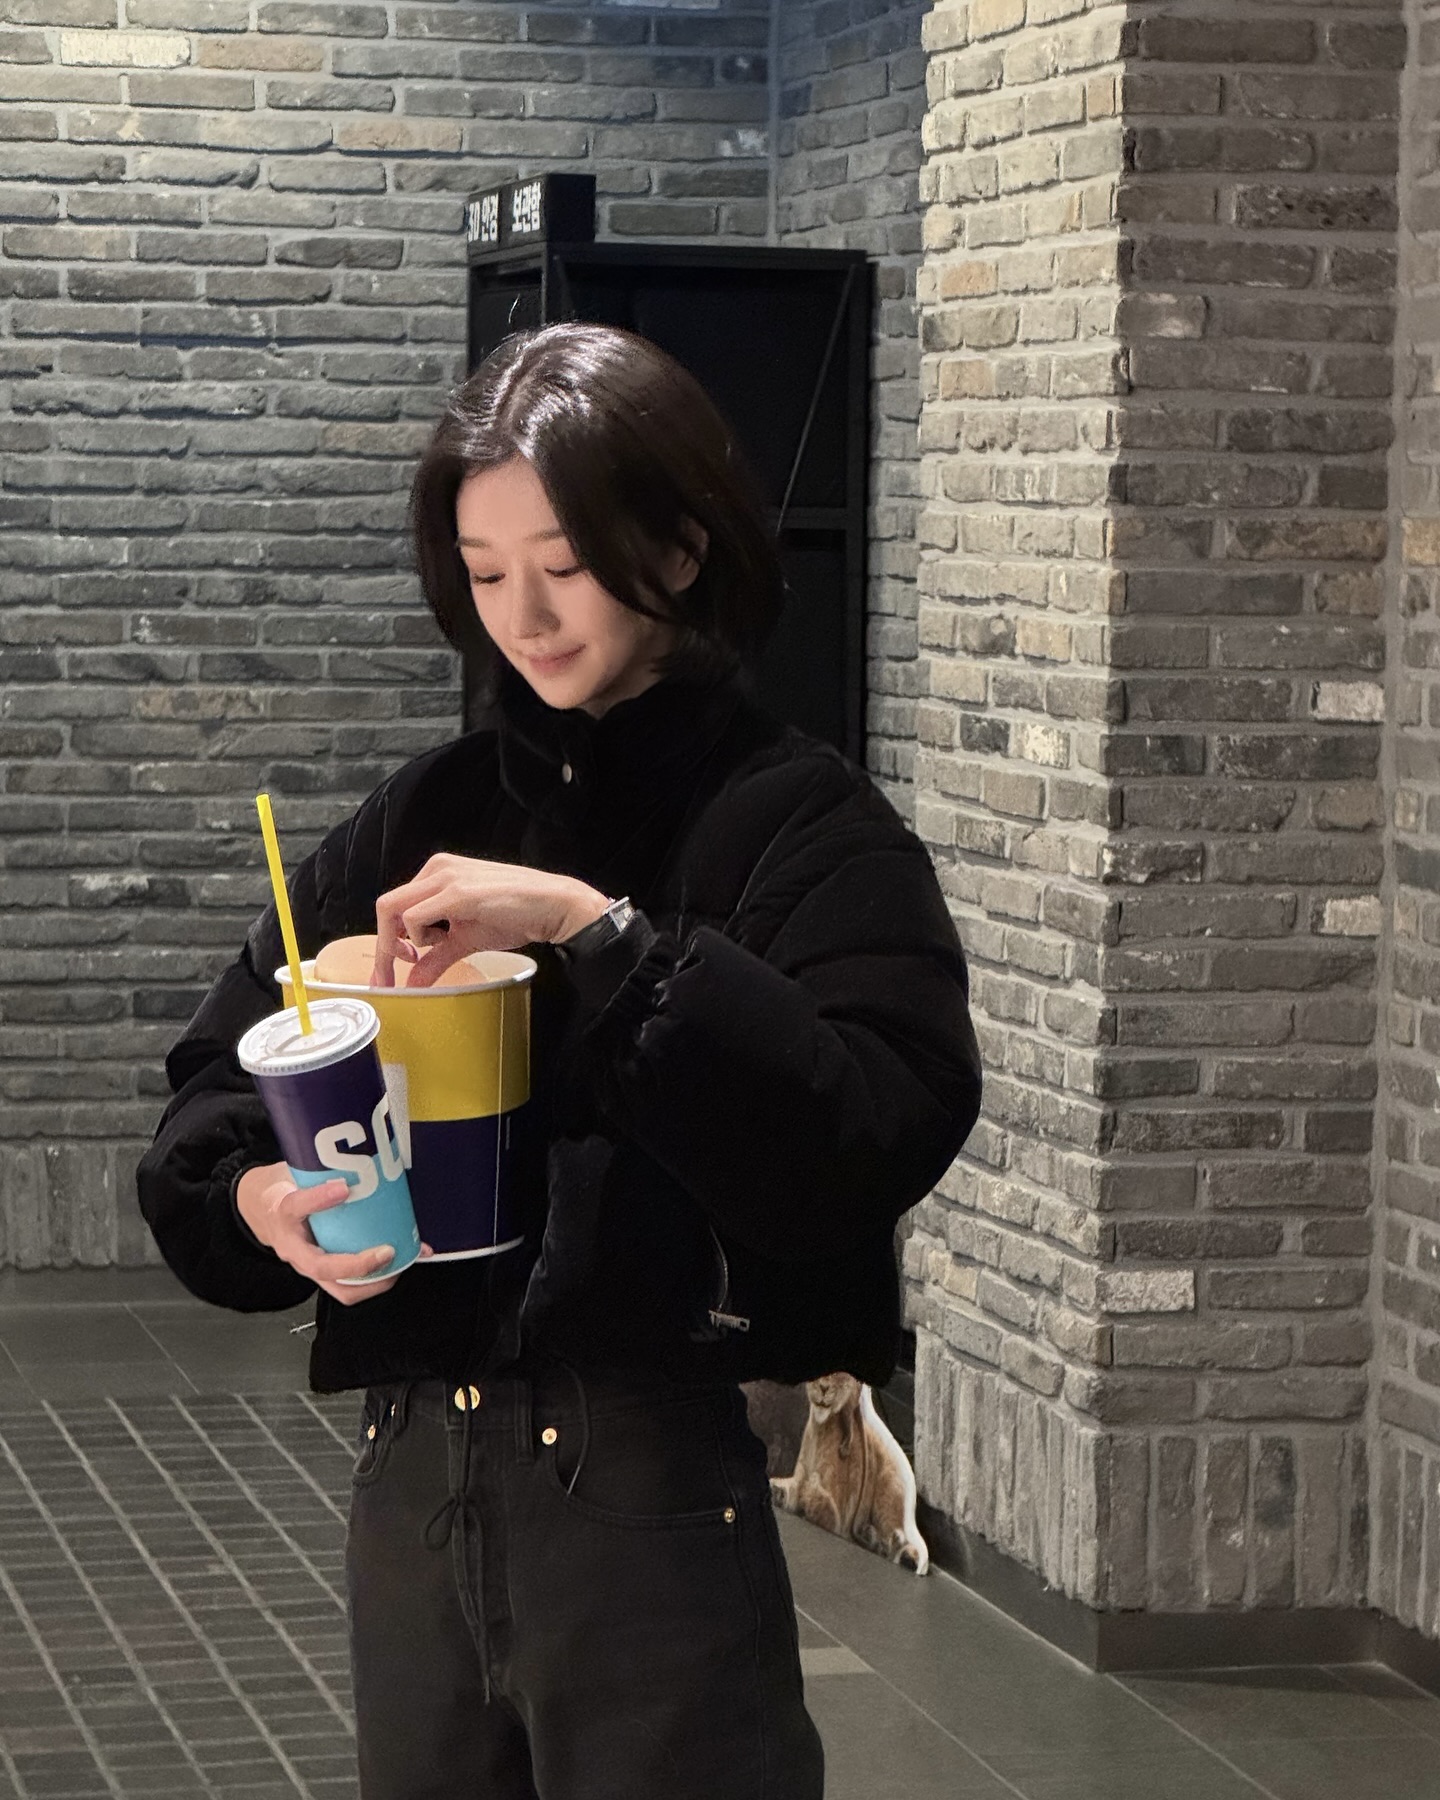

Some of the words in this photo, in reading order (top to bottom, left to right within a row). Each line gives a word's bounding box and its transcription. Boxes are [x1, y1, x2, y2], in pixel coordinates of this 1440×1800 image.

[468, 202, 480, 242] 3D
[481, 193, 499, 241] 안경
[511, 182, 541, 232] 보관함
